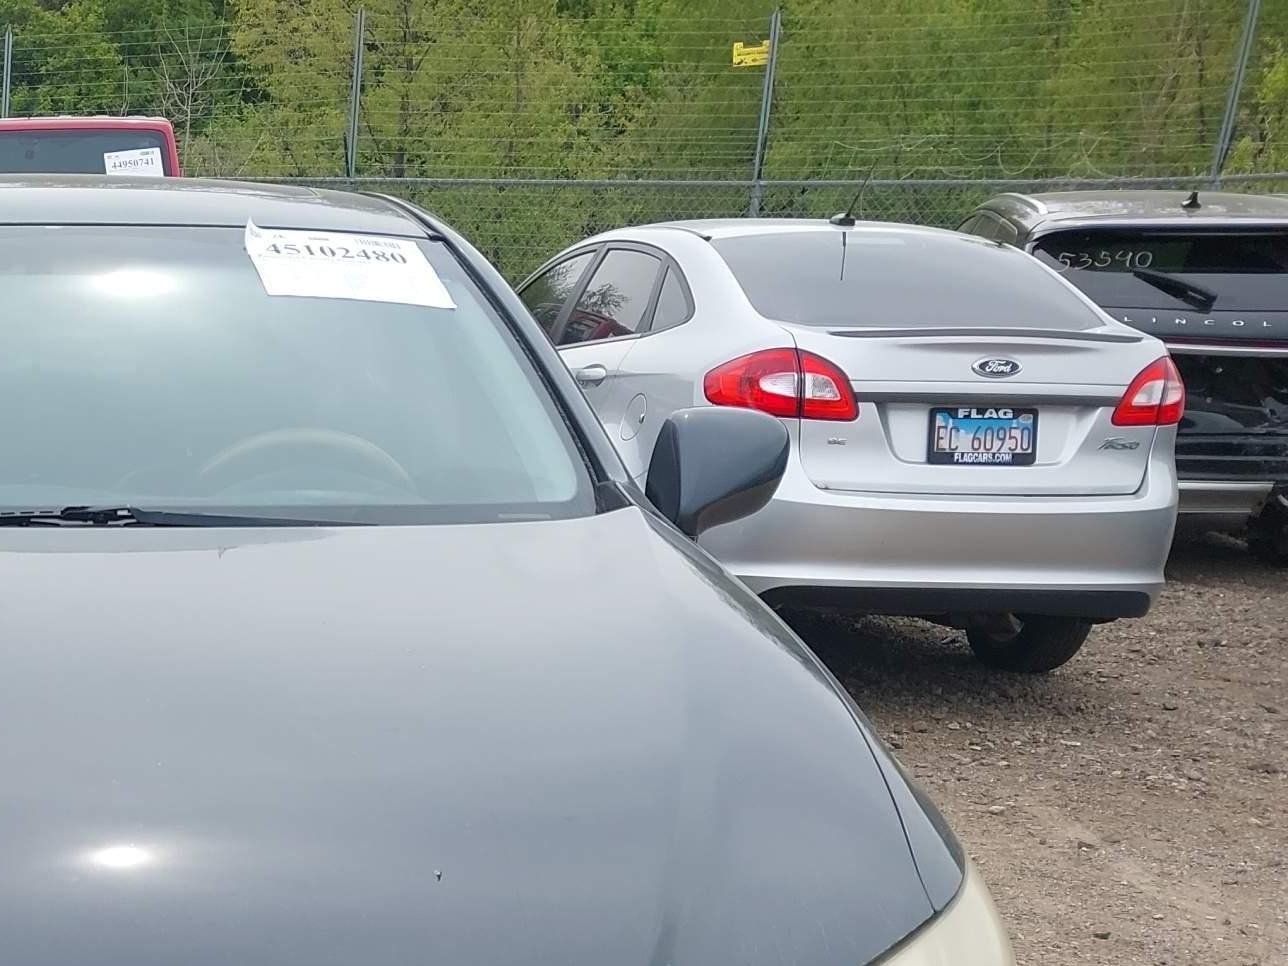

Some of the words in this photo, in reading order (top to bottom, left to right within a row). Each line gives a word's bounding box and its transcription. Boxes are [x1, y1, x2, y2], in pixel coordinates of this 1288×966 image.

[266, 242, 408, 265] 45102480
[958, 408, 1014, 419] FLAG
[936, 426, 960, 451] EC
[971, 426, 1031, 452] 60950
[954, 453, 1012, 463] FLAGCARS.COM
